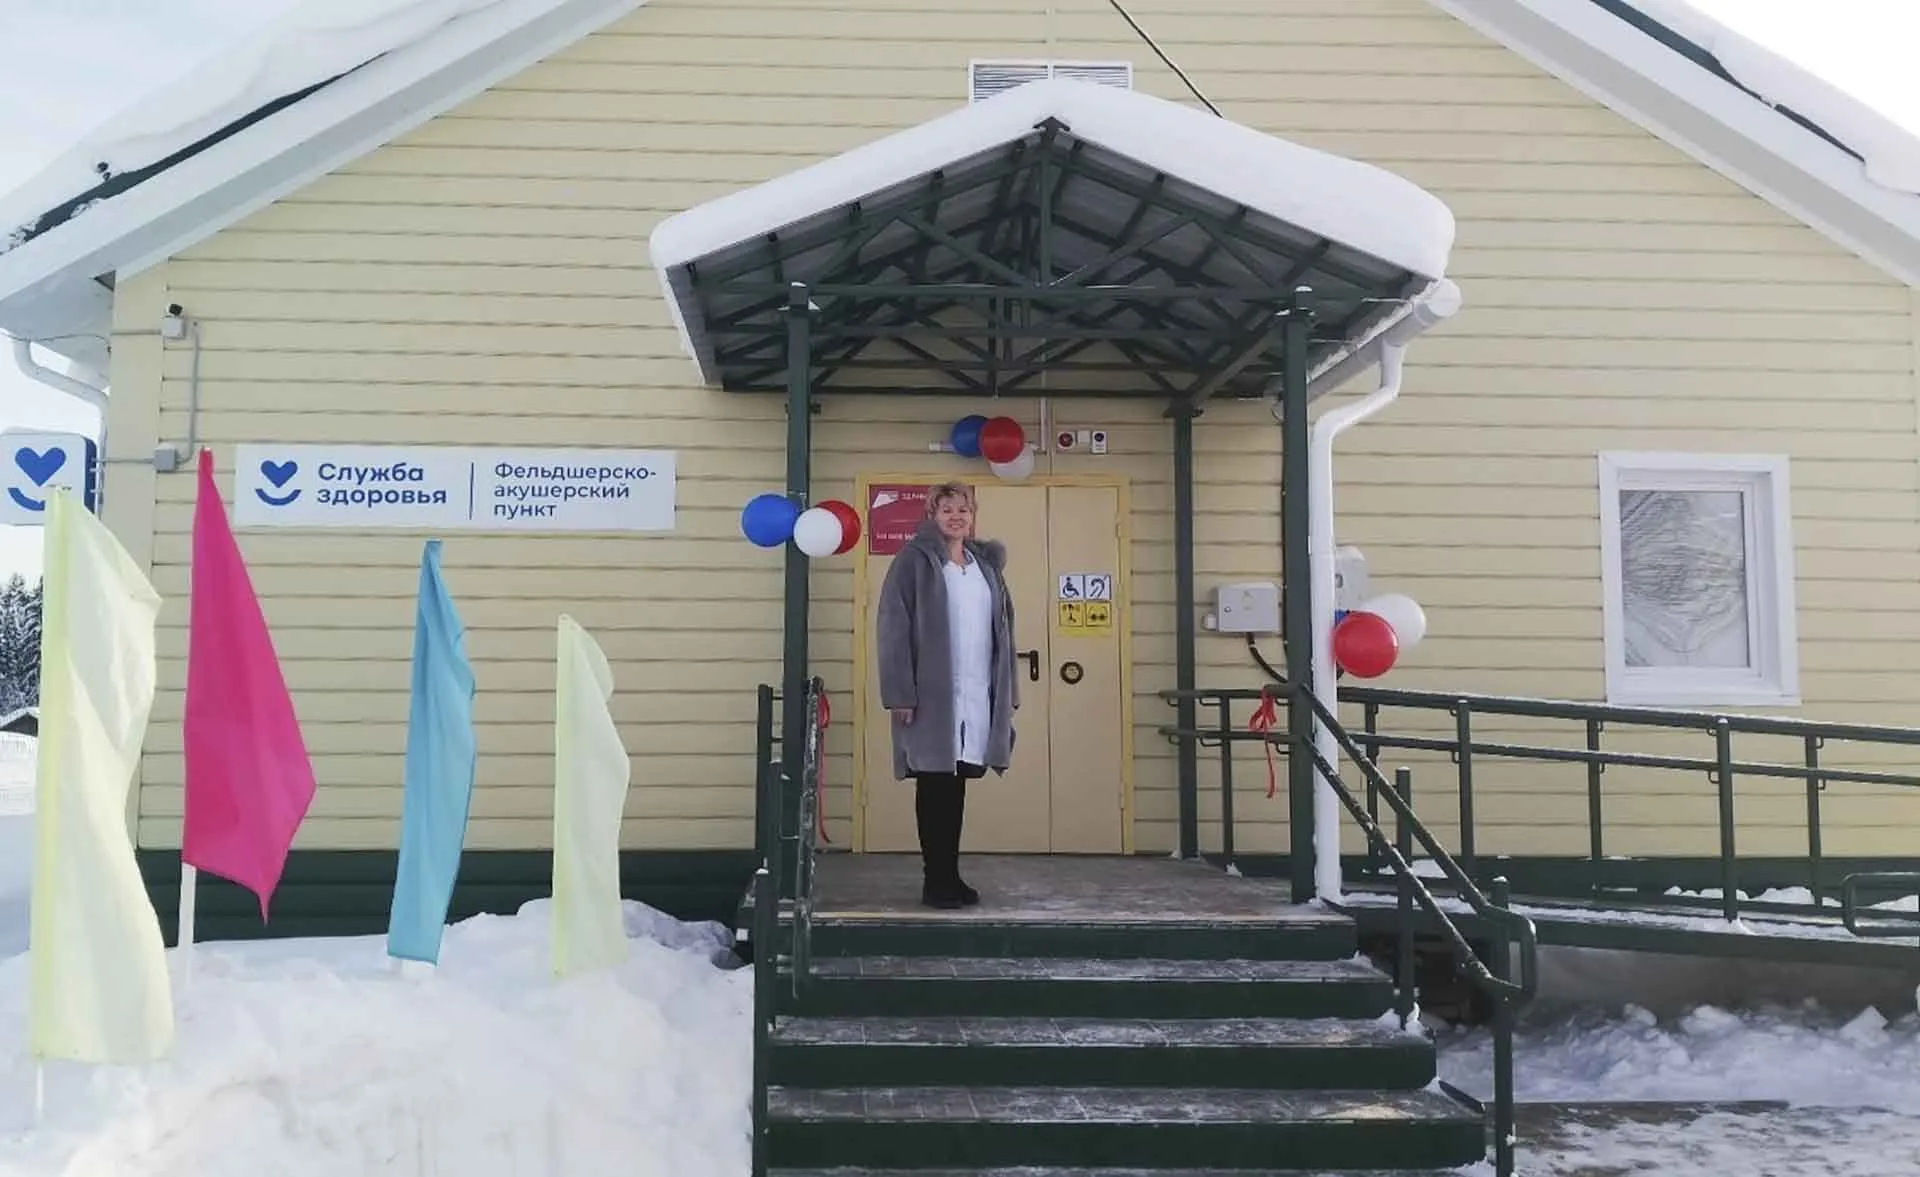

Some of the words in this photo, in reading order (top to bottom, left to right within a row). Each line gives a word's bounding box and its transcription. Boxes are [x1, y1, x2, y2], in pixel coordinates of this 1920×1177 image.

[318, 462, 423, 484] Служба
[495, 462, 656, 482] Фельдшерско-
[317, 487, 446, 508] здоровья
[495, 482, 630, 501] акушерский
[495, 503, 557, 520] пункт
